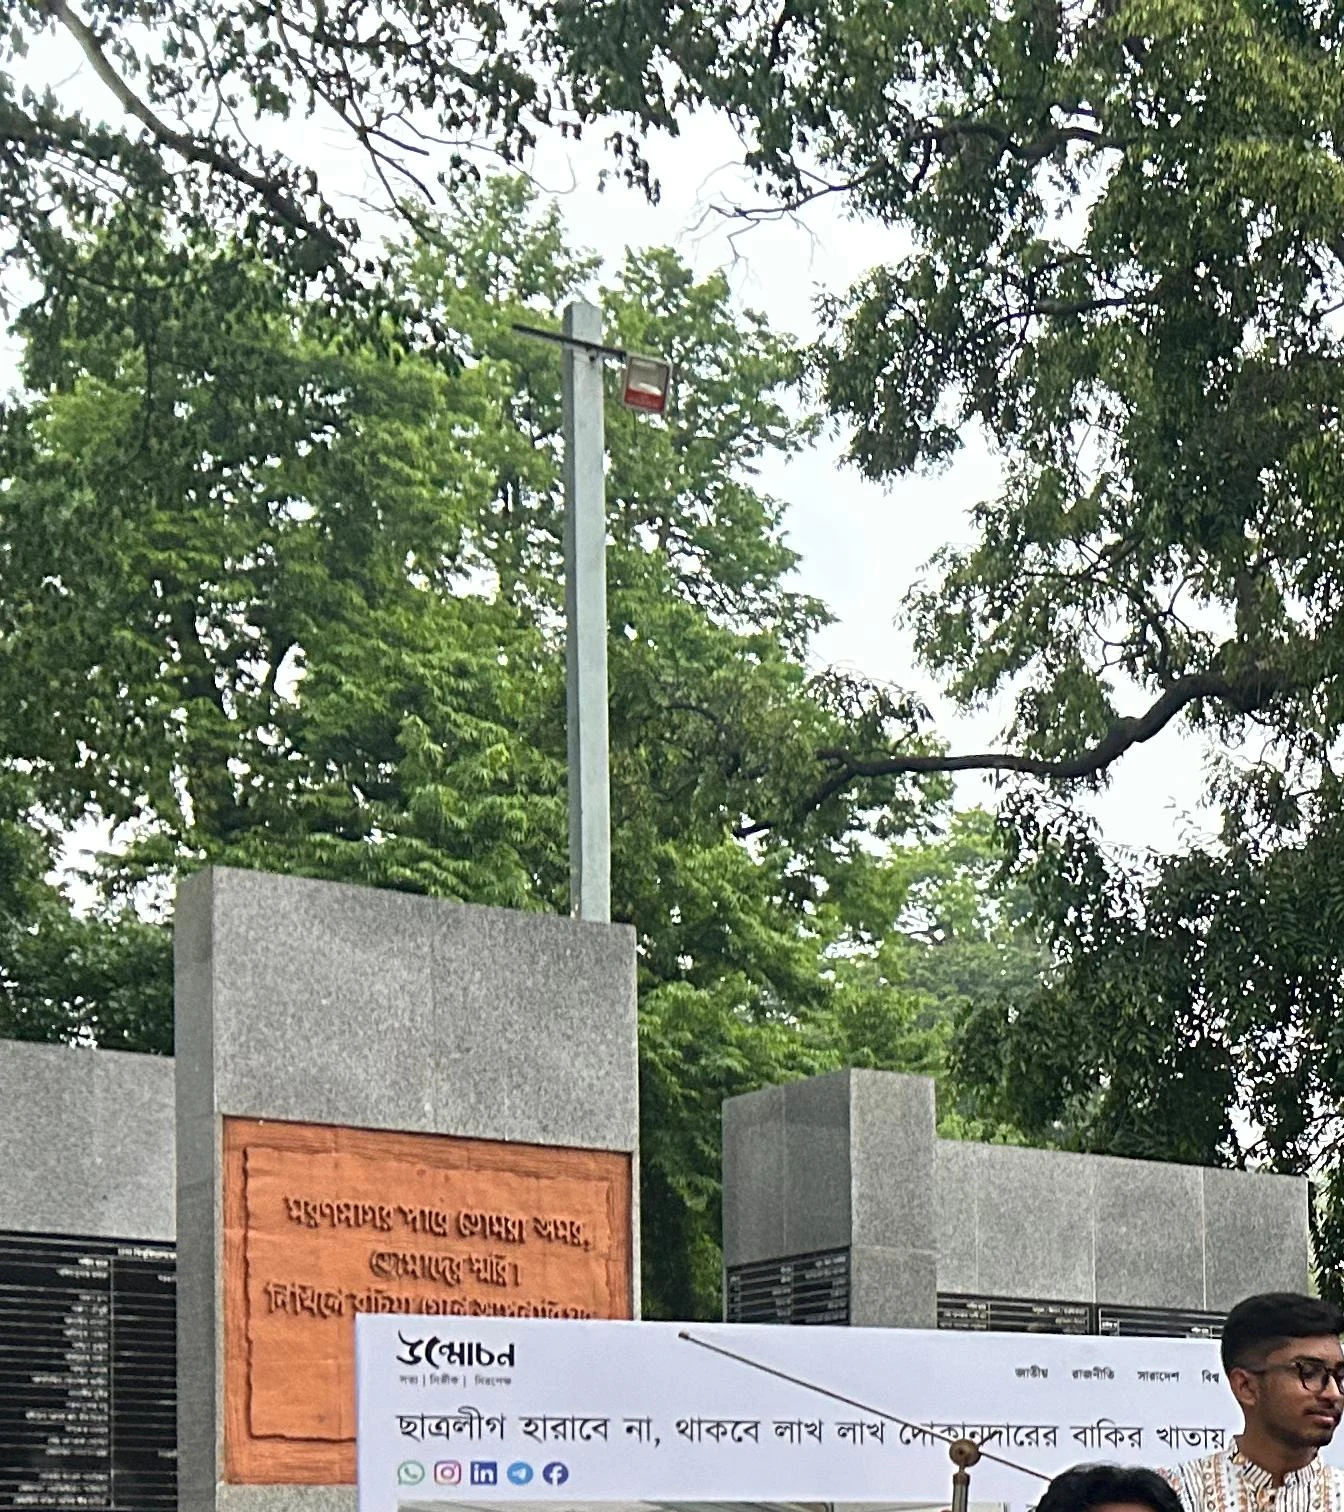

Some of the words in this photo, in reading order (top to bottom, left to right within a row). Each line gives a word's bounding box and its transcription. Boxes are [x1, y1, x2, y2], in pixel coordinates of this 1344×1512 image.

[397, 1206, 448, 1238] পারে
[455, 1209, 526, 1245] তোমরা
[369, 1250, 463, 1287] তোমাদের
[396, 1329, 516, 1370] উন্মোচন
[1015, 1365, 1048, 1379] জাতীয়
[1072, 1365, 1115, 1381] রাজনীতি
[1137, 1370, 1180, 1383] সারাদেশ
[396, 1405, 506, 1441] ছাত্রলীগ
[518, 1414, 610, 1443] হারাবে
[622, 1415, 661, 1448] না,
[675, 1417, 761, 1444] থাকবে
[772, 1418, 824, 1445] লাখ
[835, 1419, 886, 1446] লাখ
[1070, 1418, 1145, 1449] বাকির
[1155, 1424, 1227, 1451] খাতায়
